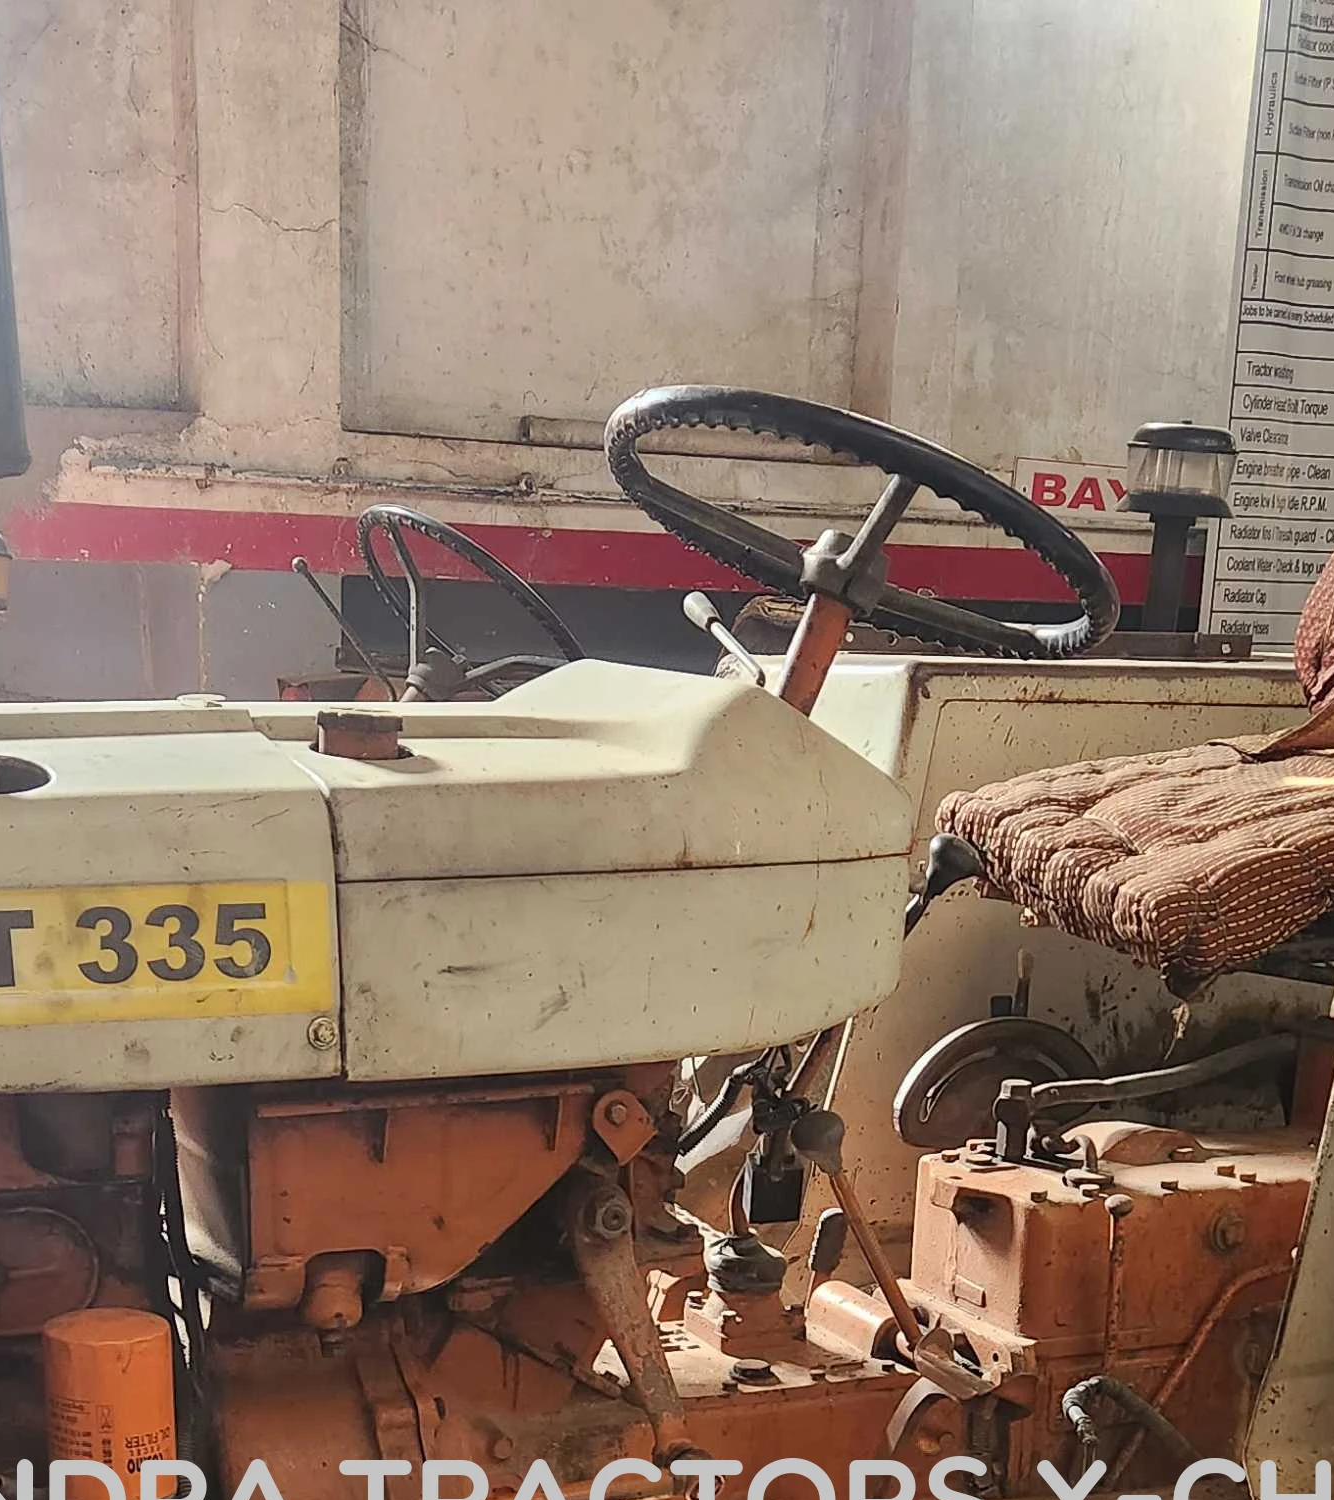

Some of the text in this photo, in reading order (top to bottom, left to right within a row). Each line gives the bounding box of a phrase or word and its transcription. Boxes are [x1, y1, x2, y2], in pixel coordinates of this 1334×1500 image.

[1265, 71, 1279, 137] Hydraulics
[1255, 169, 1268, 239] Transmission
[1242, 305, 1258, 317] Jobs
[1246, 361, 1273, 377] Tractor
[1242, 393, 1273, 413] Cylinder
[1300, 399, 1329, 419] Torque
[1240, 427, 1262, 443] Valve
[1236, 459, 1263, 480] Engine
[1307, 464, 1331, 481] Clean
[1233, 492, 1260, 512] Engine
[1300, 496, 1328, 513] R.P.M.
[1230, 524, 1262, 541] Radiator
[1294, 528, 1318, 547] guard
[1226, 557, 1256, 573] Coolant
[1301, 560, 1315, 577] top
[1223, 588, 1267, 607] Radiator Cap
[1220, 619, 1252, 635] Radiator
[77, 902, 272, 984] 335
[125, 1432, 159, 1449] FILTER
